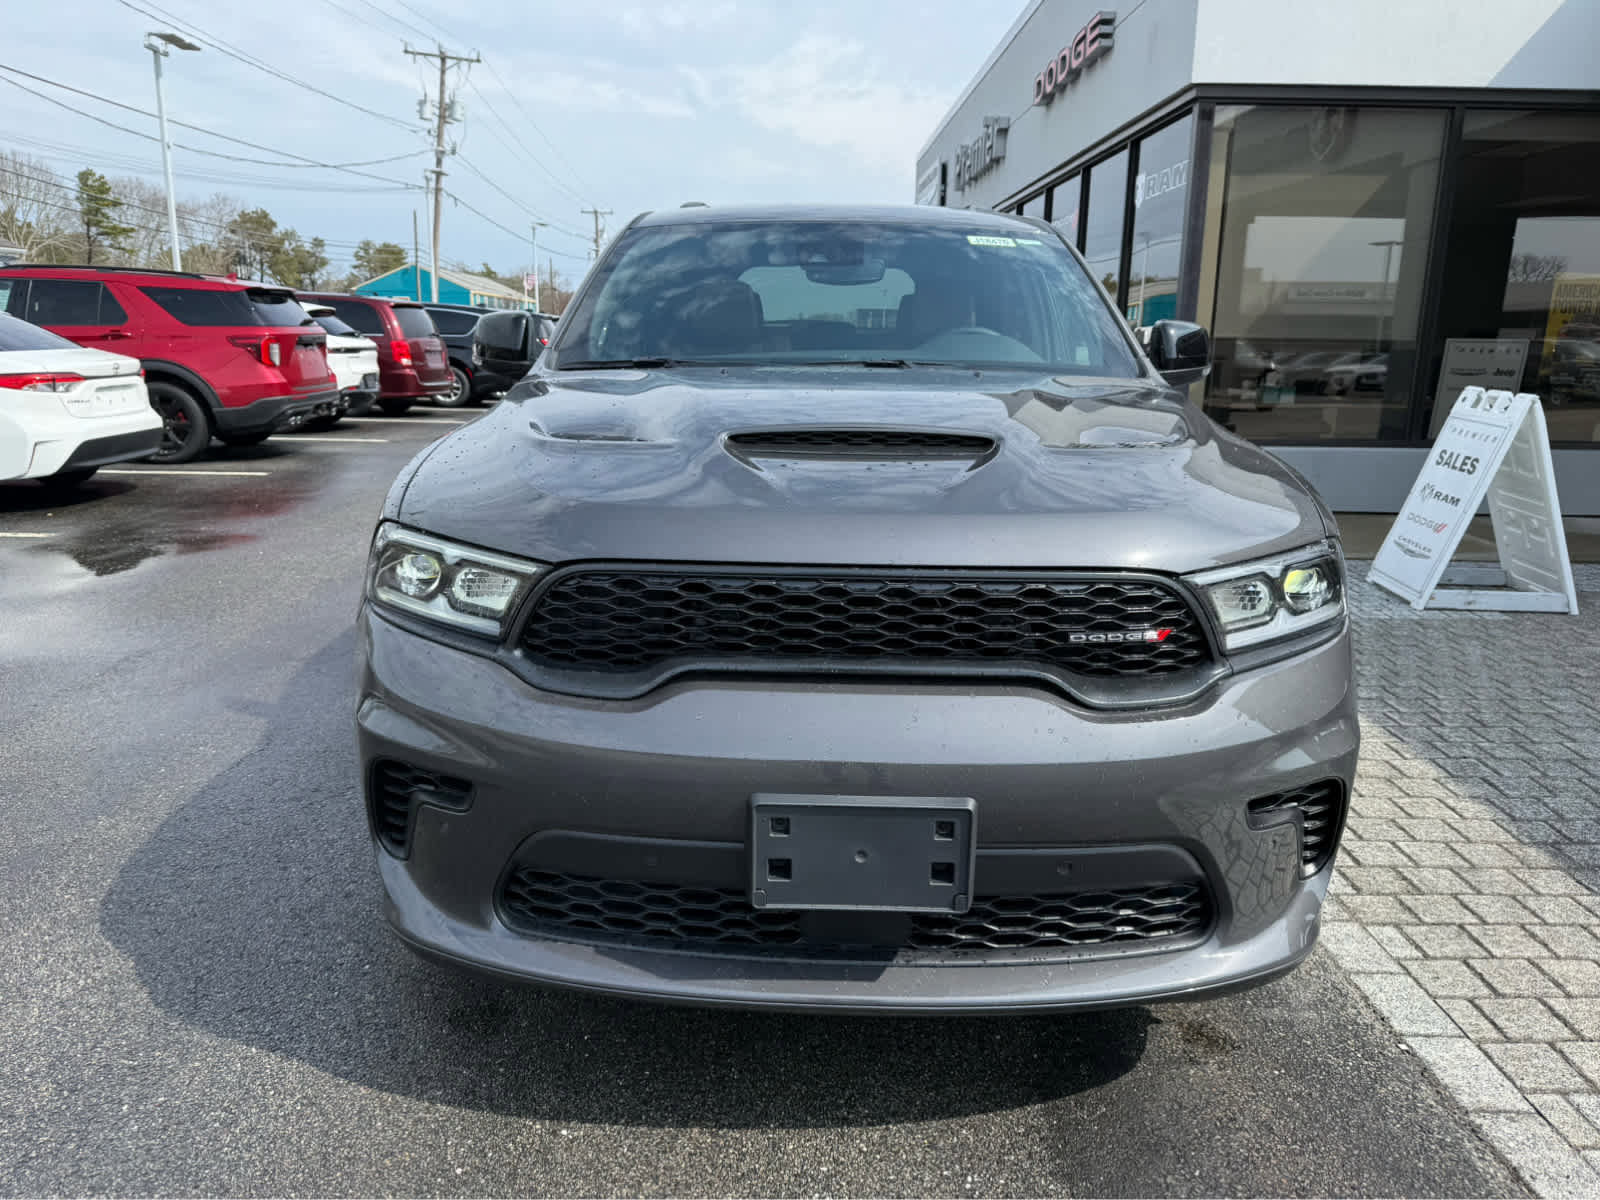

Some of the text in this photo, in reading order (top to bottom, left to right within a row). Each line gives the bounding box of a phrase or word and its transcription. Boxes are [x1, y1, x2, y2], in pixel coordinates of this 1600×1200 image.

[1032, 11, 1117, 106] DODGE
[1145, 160, 1191, 200] RAM
[1435, 449, 1480, 475] SALES
[1432, 491, 1461, 507] RAM
[1069, 631, 1159, 642] DODGE
